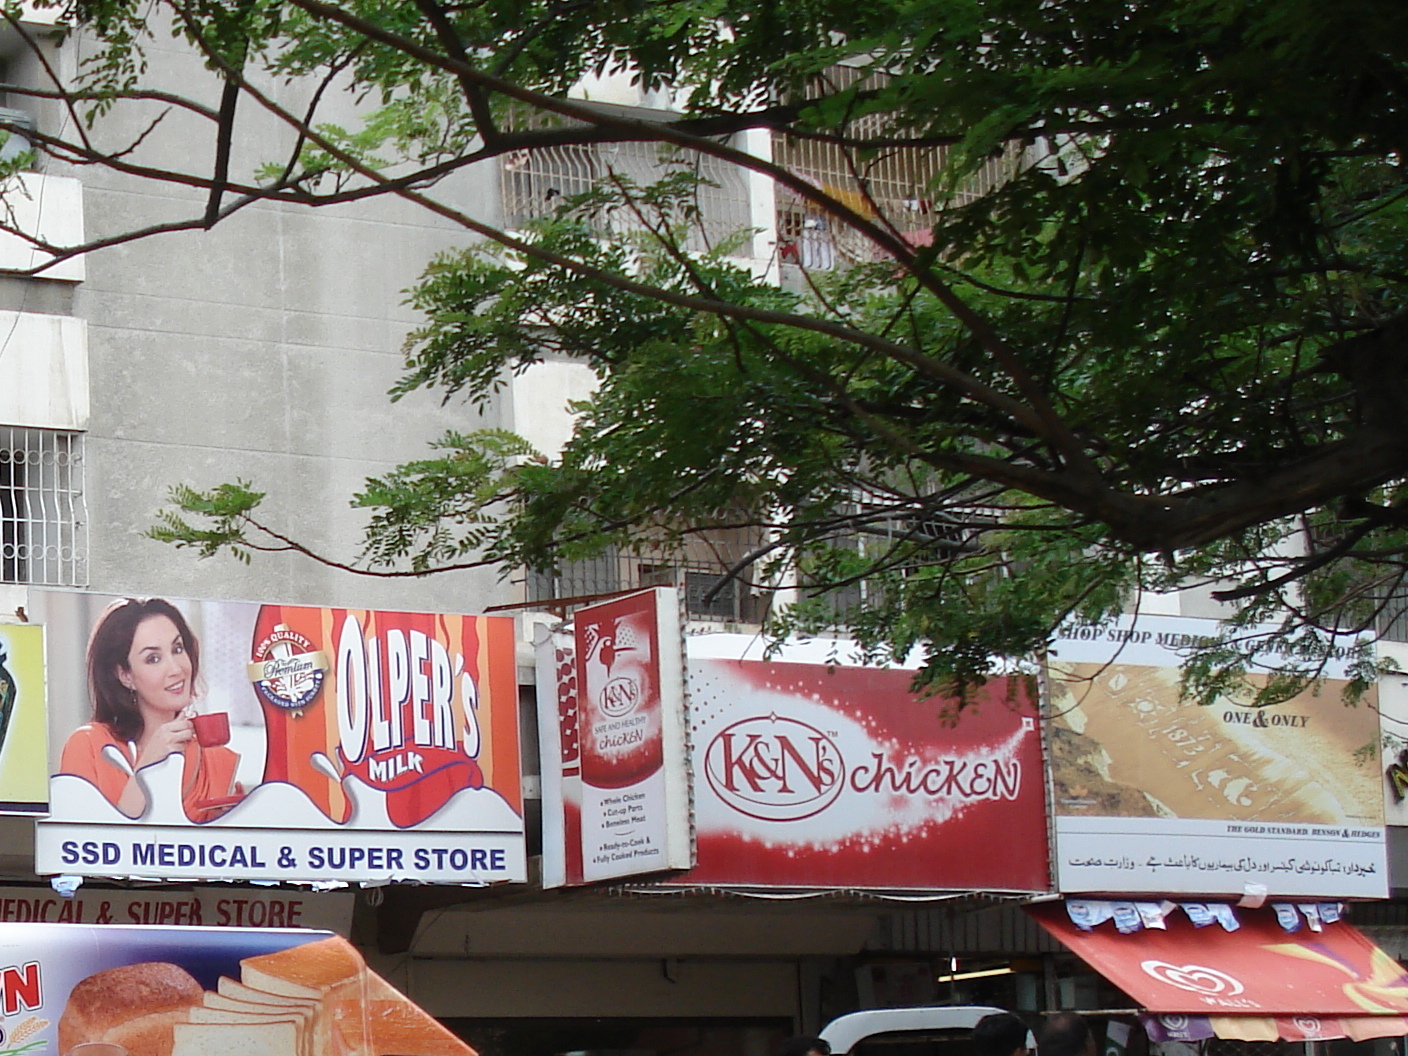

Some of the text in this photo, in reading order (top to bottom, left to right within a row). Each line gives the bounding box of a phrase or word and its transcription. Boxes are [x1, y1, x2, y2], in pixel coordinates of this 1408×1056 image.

[270, 632, 311, 648] QUALITY
[1106, 630, 1152, 644] SHOP
[1223, 709, 1311, 729] ONE & ONLY
[368, 751, 423, 783] MILK
[623, 792, 646, 803] Chicken
[627, 805, 643, 815] Parts
[1244, 826, 1265, 834] GOLD
[1267, 827, 1308, 836] STANDARD
[1311, 829, 1340, 837] BENSON
[1342, 829, 1349, 838] &
[1350, 830, 1381, 839] HEDGES
[61, 841, 507, 871] SSD MEDICAL & SUPER STORE
[96, 901, 114, 924] &
[127, 897, 203, 926] SUPER
[216, 899, 304, 928] STORE
